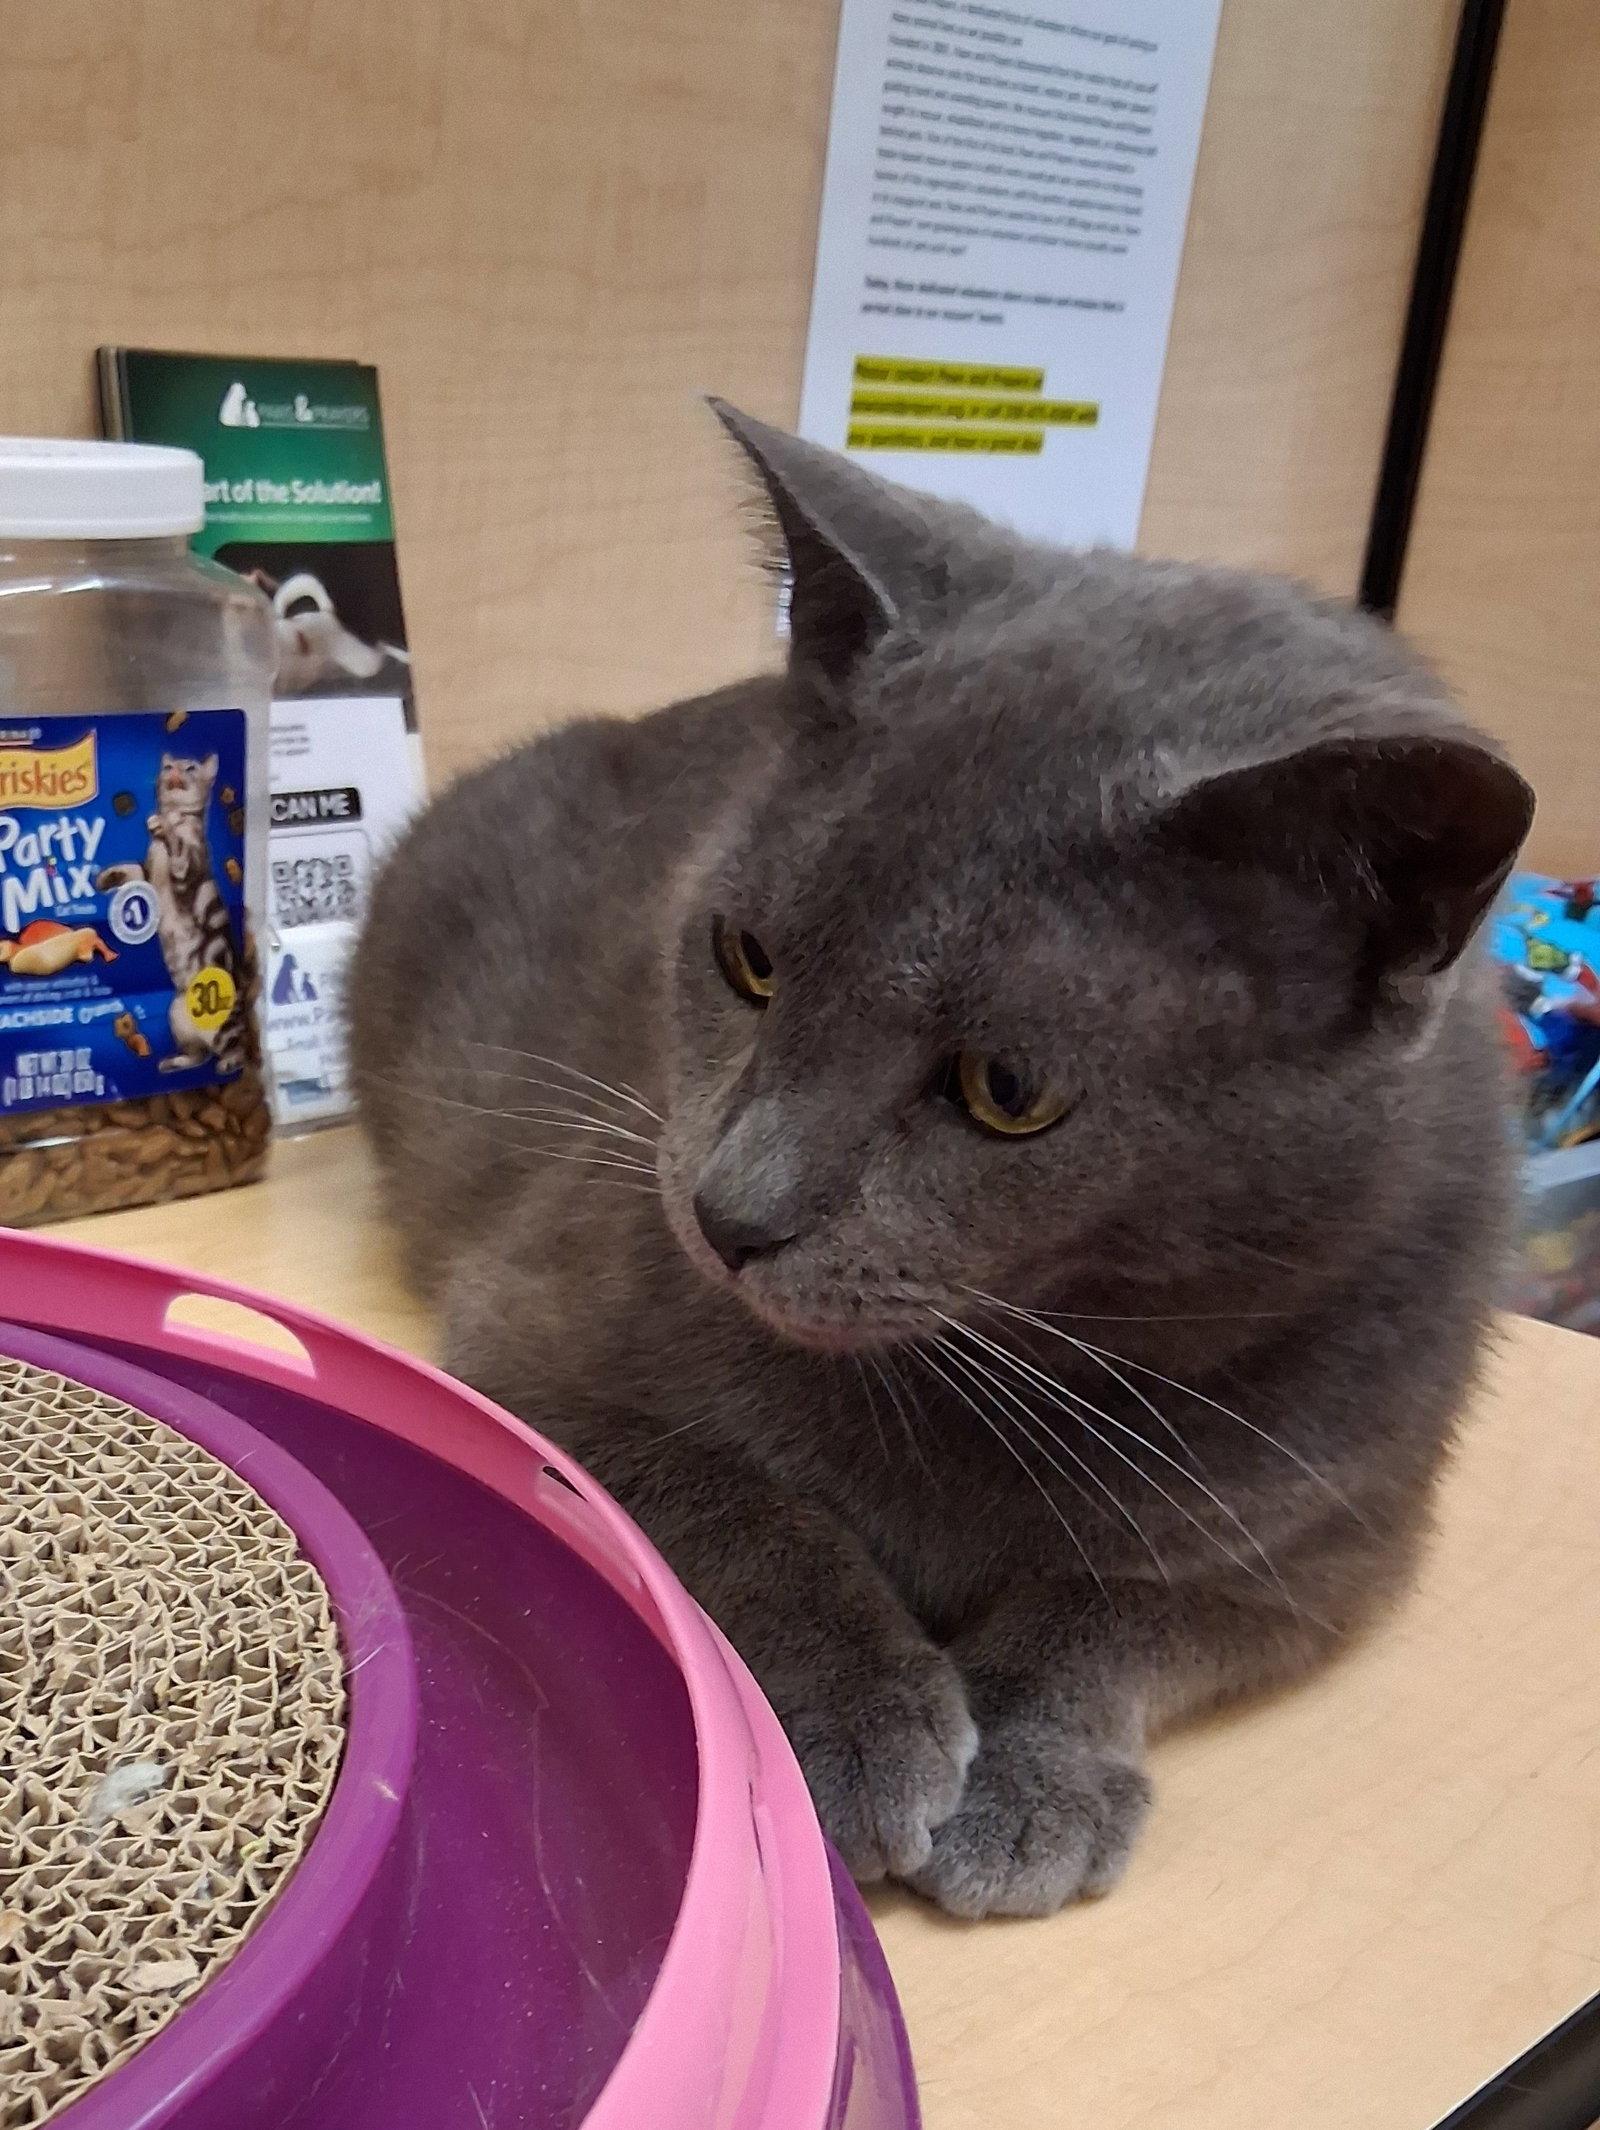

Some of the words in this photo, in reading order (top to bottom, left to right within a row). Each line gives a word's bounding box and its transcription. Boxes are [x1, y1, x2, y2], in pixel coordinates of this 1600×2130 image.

[0, 759, 88, 797] riskies
[0, 816, 106, 873] Party
[3, 863, 96, 933] Mix
